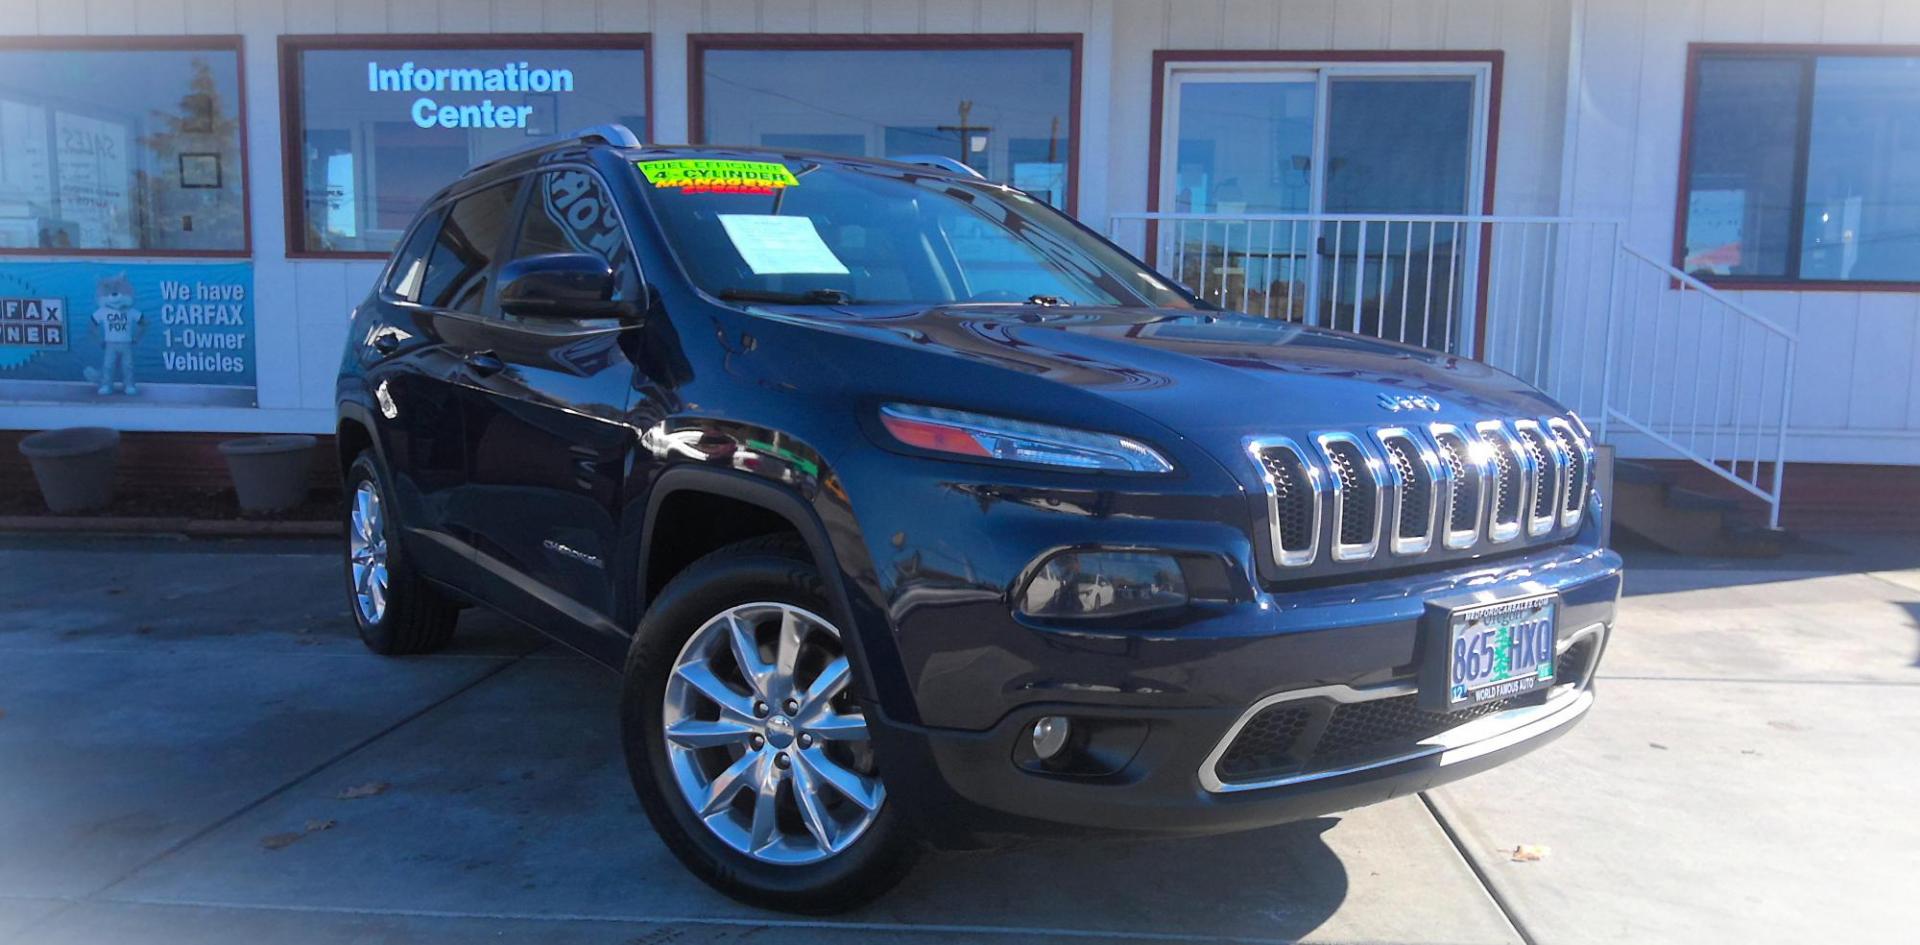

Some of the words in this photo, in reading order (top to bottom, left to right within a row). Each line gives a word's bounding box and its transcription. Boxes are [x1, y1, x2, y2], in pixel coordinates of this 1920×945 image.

[368, 62, 574, 92] Information
[411, 98, 533, 128] Center
[644, 162, 685, 170] FUEL
[682, 170, 786, 181] CYLINDER
[160, 281, 190, 301] We
[196, 281, 245, 301] have
[107, 313, 128, 321] CAR
[161, 304, 244, 326] CARFAX
[163, 329, 245, 349] 1-Owner
[162, 352, 244, 373] Vehicles
[1453, 628, 1496, 684] 865
[1453, 687, 1463, 699] 12
[1475, 687, 1496, 701] WORLD
[1496, 682, 1519, 697] FAMOUS
[1519, 678, 1535, 690] AUTO
